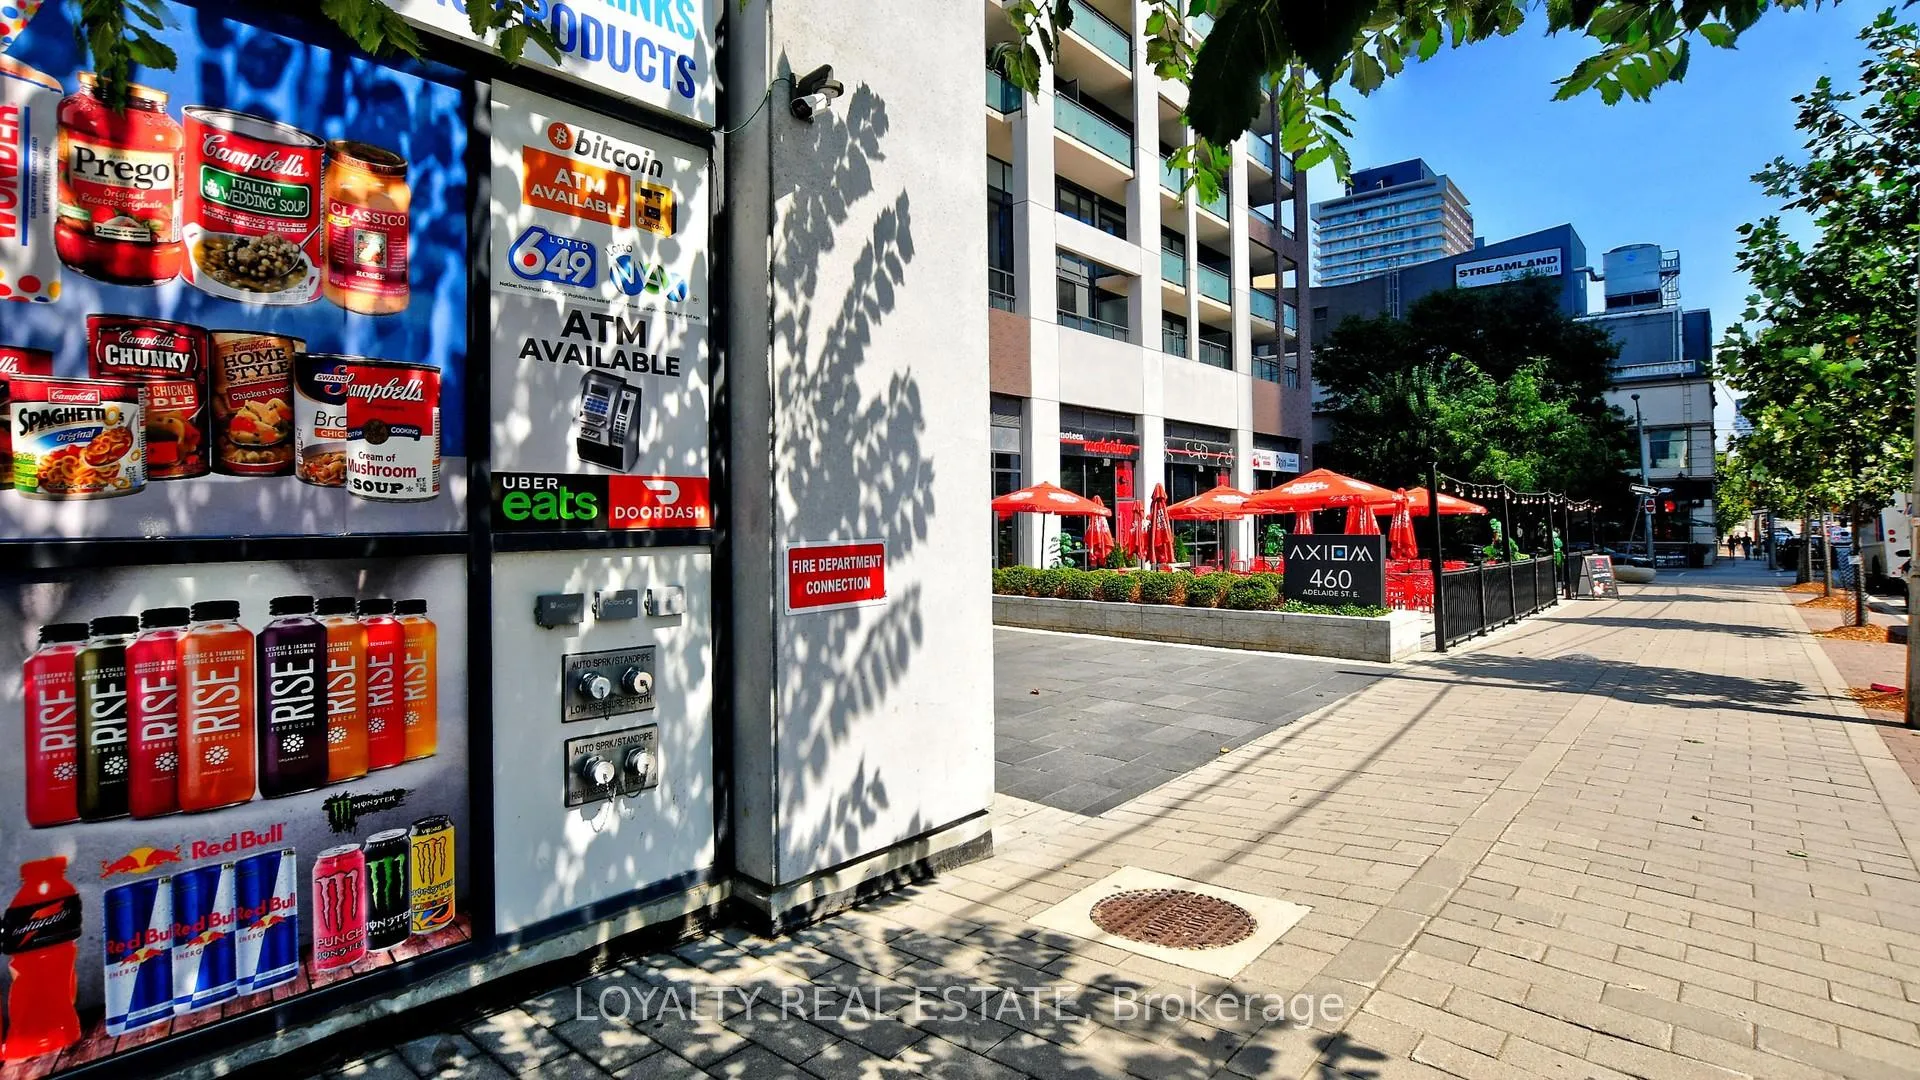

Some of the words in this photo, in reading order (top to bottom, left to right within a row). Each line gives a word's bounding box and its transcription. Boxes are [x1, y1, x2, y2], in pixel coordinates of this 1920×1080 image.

[496, 0, 696, 98] RODUCTS
[203, 132, 306, 178] Campbell's
[574, 130, 663, 178] bitcoin
[73, 145, 170, 190] Prego
[232, 178, 281, 197] ITALIAN
[554, 168, 606, 196] ATM
[221, 186, 276, 211] WEDDING
[279, 199, 306, 213] SOUP
[531, 183, 626, 218] AVAILABLE
[331, 202, 406, 226] CLASSICO
[550, 236, 589, 250] LOTTO
[1458, 255, 1558, 278] STREAMLAND
[119, 330, 175, 348] Campbell's
[561, 310, 647, 348] ATM
[233, 340, 272, 352] Campbell's
[105, 344, 190, 373] CHUNKY
[223, 348, 288, 368] HOME
[518, 337, 680, 377] AVAILABLE
[226, 360, 288, 381] STYLE
[153, 384, 193, 397] CHICKEN
[232, 390, 267, 401] Chicken
[57, 429, 94, 442] Original
[391, 426, 419, 435] COOKING
[1060, 431, 1084, 440] noteca
[359, 451, 383, 462] Cream
[386, 453, 396, 462] of
[348, 458, 417, 478] Mushroom
[353, 478, 404, 494] SOUP
[502, 477, 558, 490] UBER
[502, 486, 598, 521] eats
[615, 506, 704, 520] DOORDASH
[1289, 544, 1374, 561] AXIOM
[792, 558, 816, 574] FIRE
[818, 554, 882, 572] DEPARTMENT
[806, 576, 871, 595] CONNECTION
[1309, 568, 1352, 589] 460
[1302, 588, 1339, 597] ADELAIDE
[293, 642, 317, 650] JASMINE
[572, 659, 592, 670] AUTO
[593, 653, 651, 667] SPRK/STANDPIPE
[271, 659, 314, 724] RISE
[327, 656, 356, 715] RISE
[142, 677, 177, 742] RISE
[192, 666, 240, 736] RISE
[570, 704, 586, 715] LOW
[39, 689, 76, 752] RISE
[90, 683, 127, 746] RISE
[574, 743, 594, 755] AUTO
[595, 731, 653, 752] SPRK/STANDPIPE
[353, 795, 396, 809] MONSTER
[192, 834, 236, 860] Red
[241, 824, 283, 849] Bull
[237, 901, 266, 920] Red
[269, 893, 296, 911] Bull
[173, 918, 205, 937] Red
[106, 934, 140, 953] Red
[317, 927, 363, 949] PUNCH
